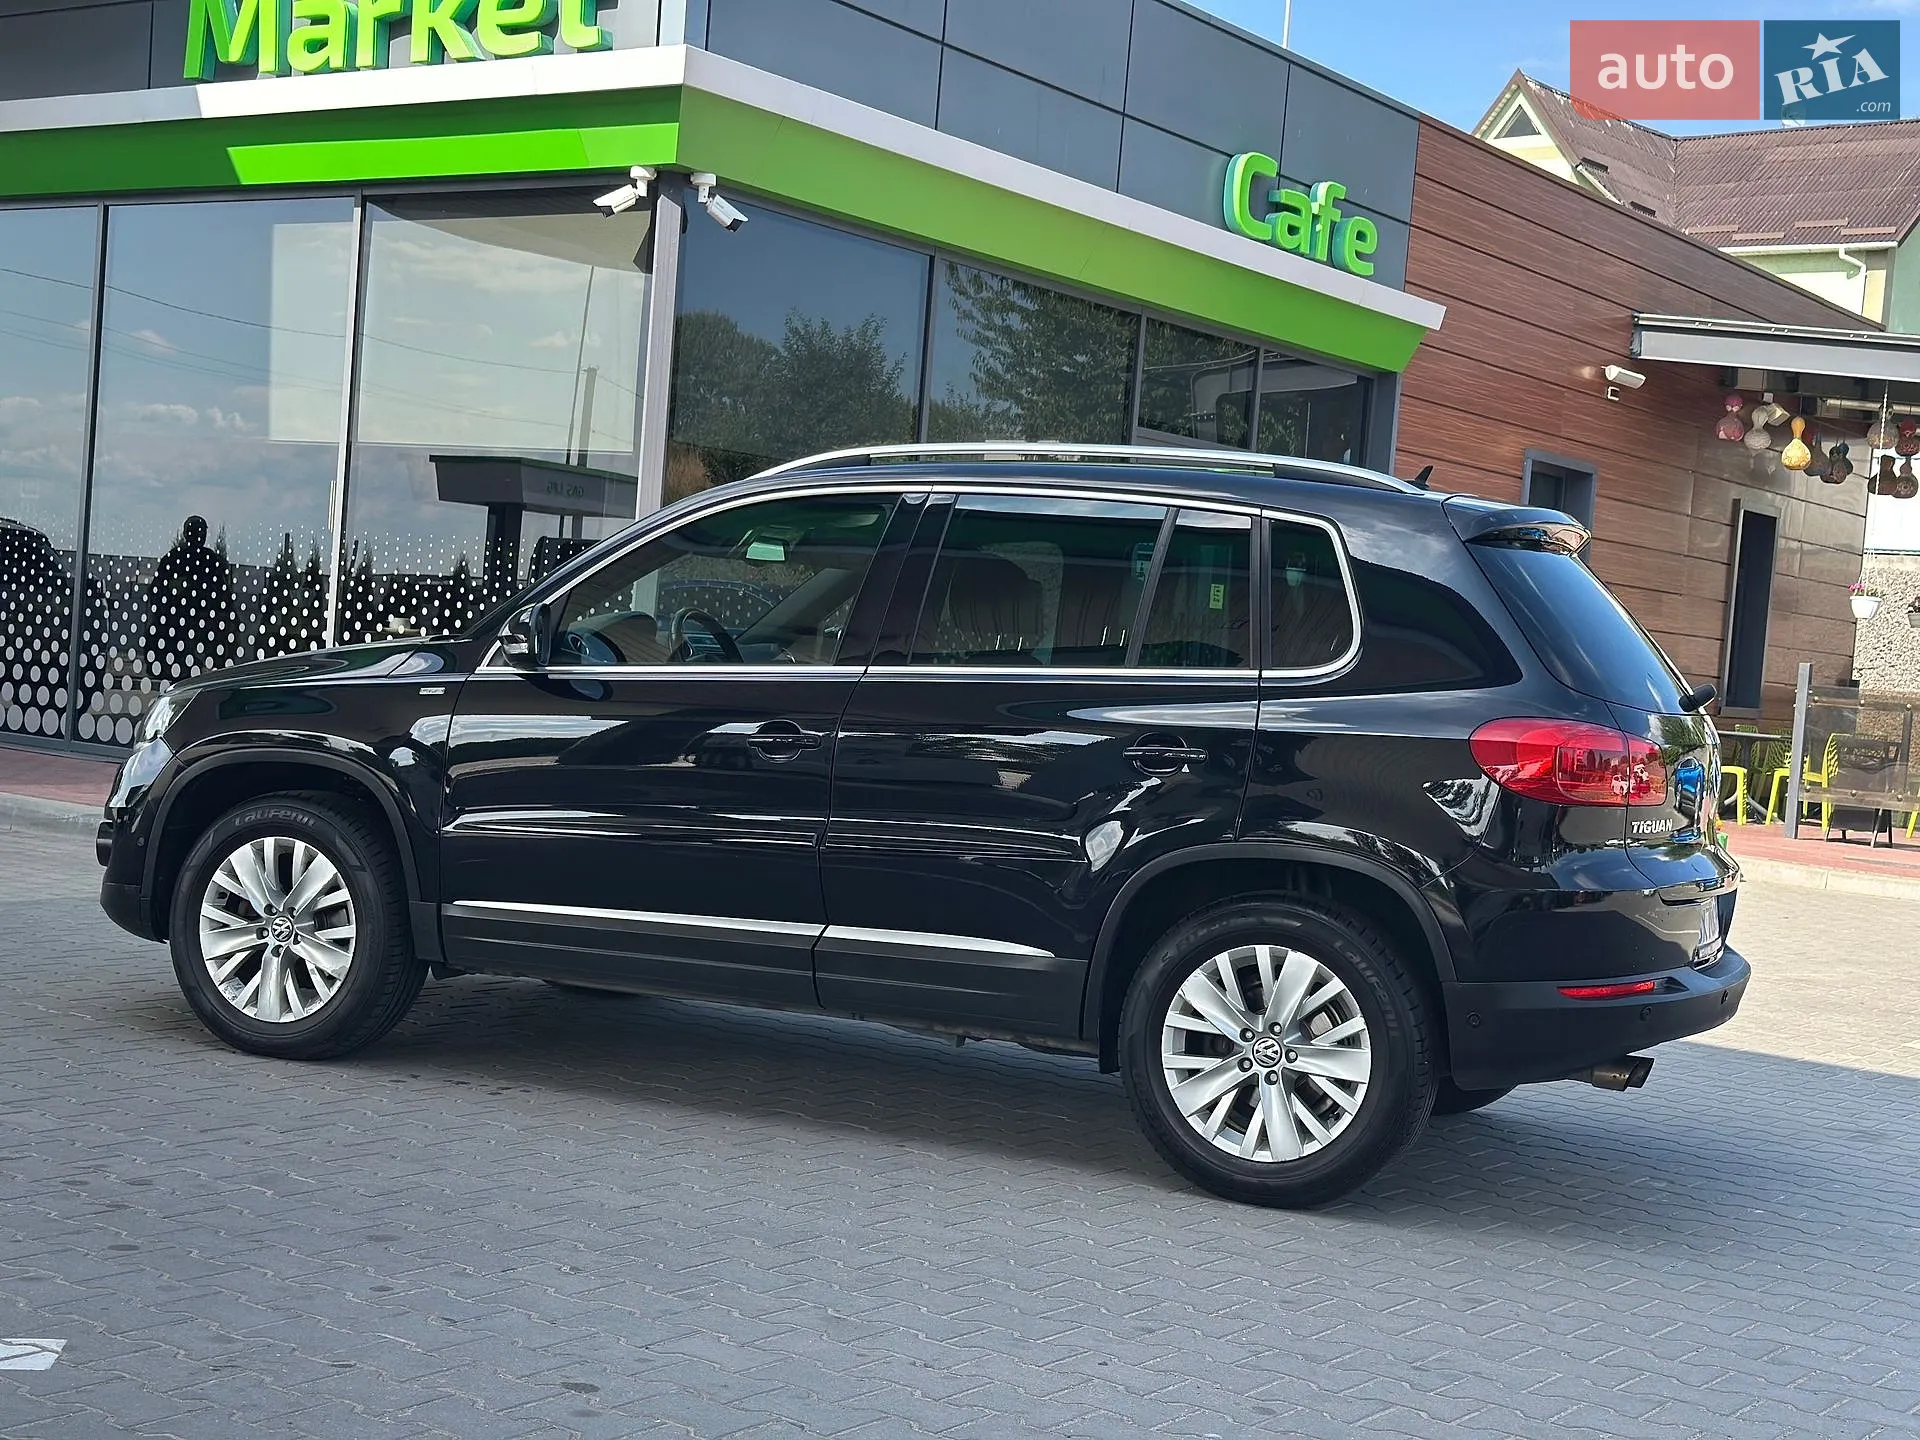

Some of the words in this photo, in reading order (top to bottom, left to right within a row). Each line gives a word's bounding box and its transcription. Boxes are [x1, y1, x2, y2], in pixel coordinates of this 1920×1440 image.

[183, 0, 613, 80] Market
[1223, 152, 1378, 276] Cafe
[1631, 819, 1673, 834] TIGUAN
